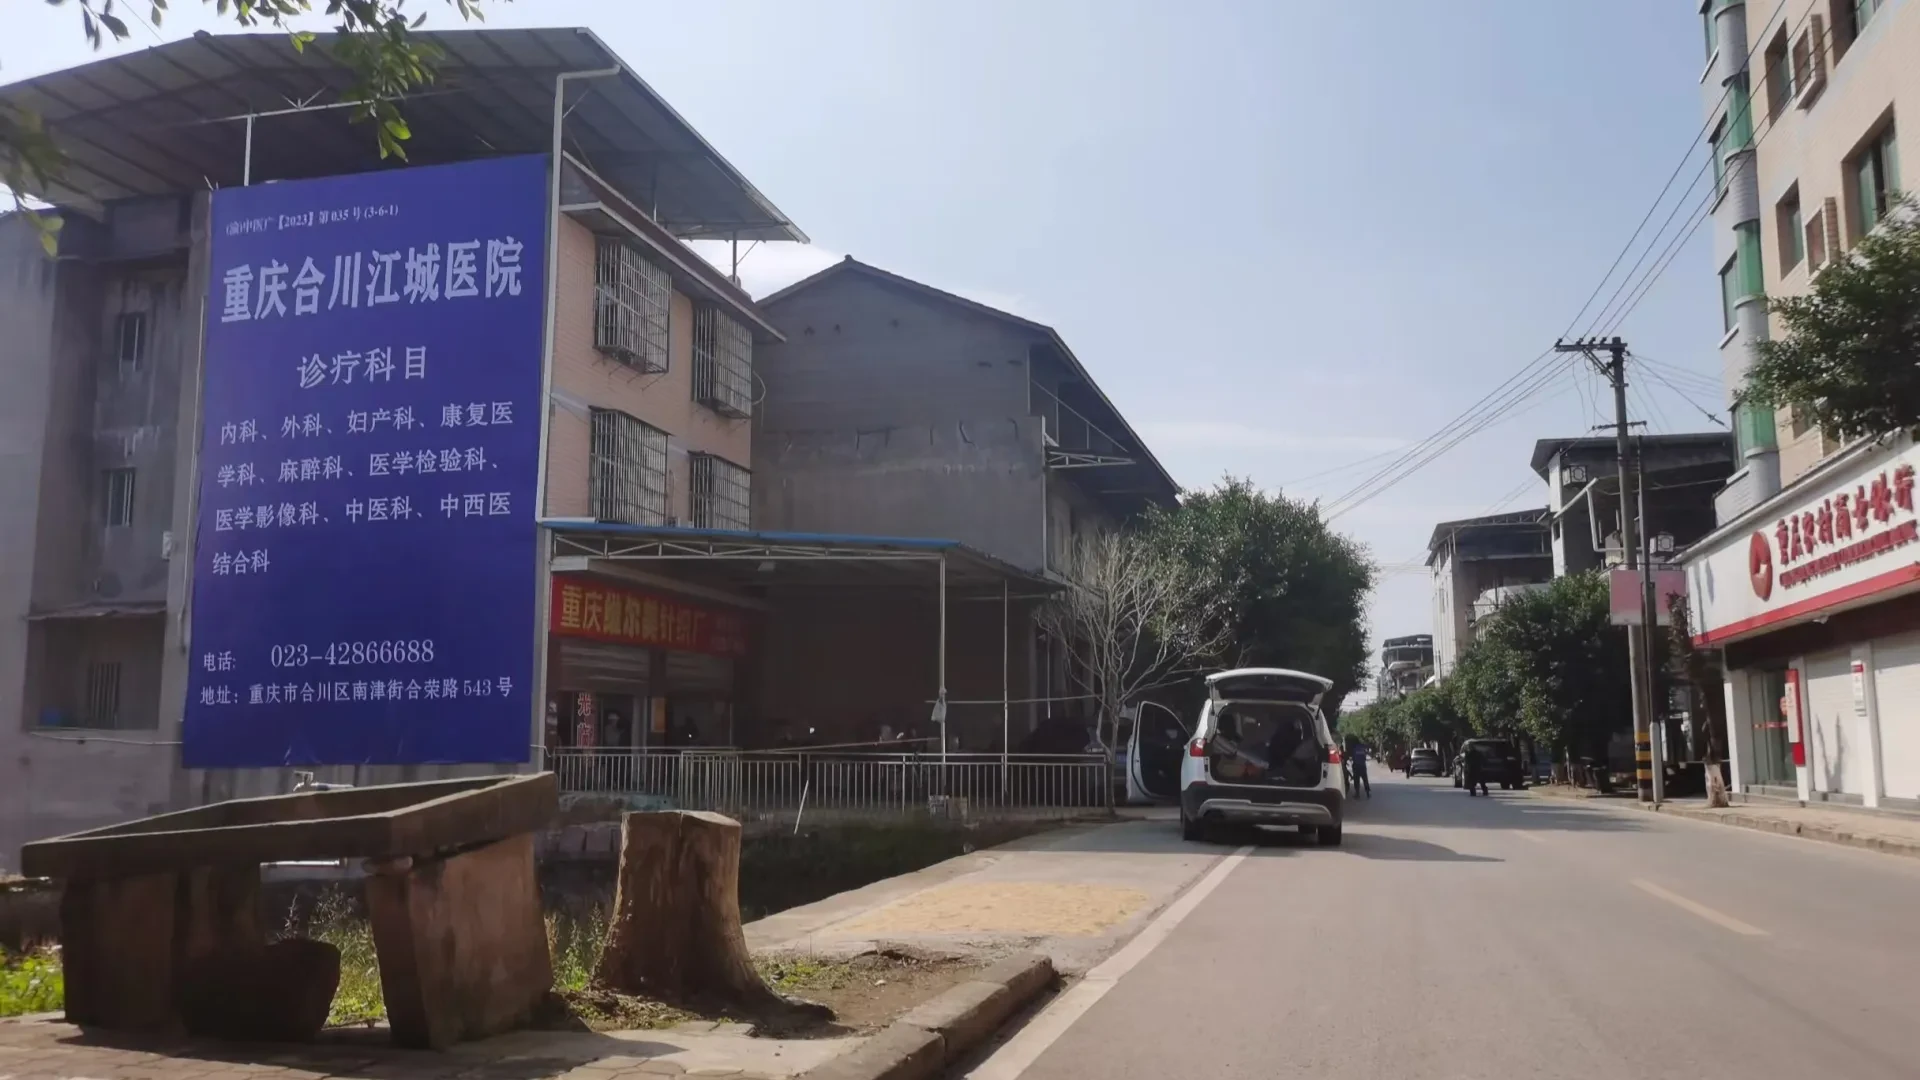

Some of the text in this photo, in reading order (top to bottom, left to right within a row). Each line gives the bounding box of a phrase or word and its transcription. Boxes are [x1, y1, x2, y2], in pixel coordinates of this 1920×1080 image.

[221, 236, 524, 323] 重庆合川江城医院
[296, 346, 427, 389] 诊疗科目
[220, 401, 514, 446] 内科、外科、妇产科、康复医
[215, 492, 512, 532] 医学影像科、中医科、中西医
[212, 548, 271, 576] 结合科
[270, 639, 435, 668] 023-42866688
